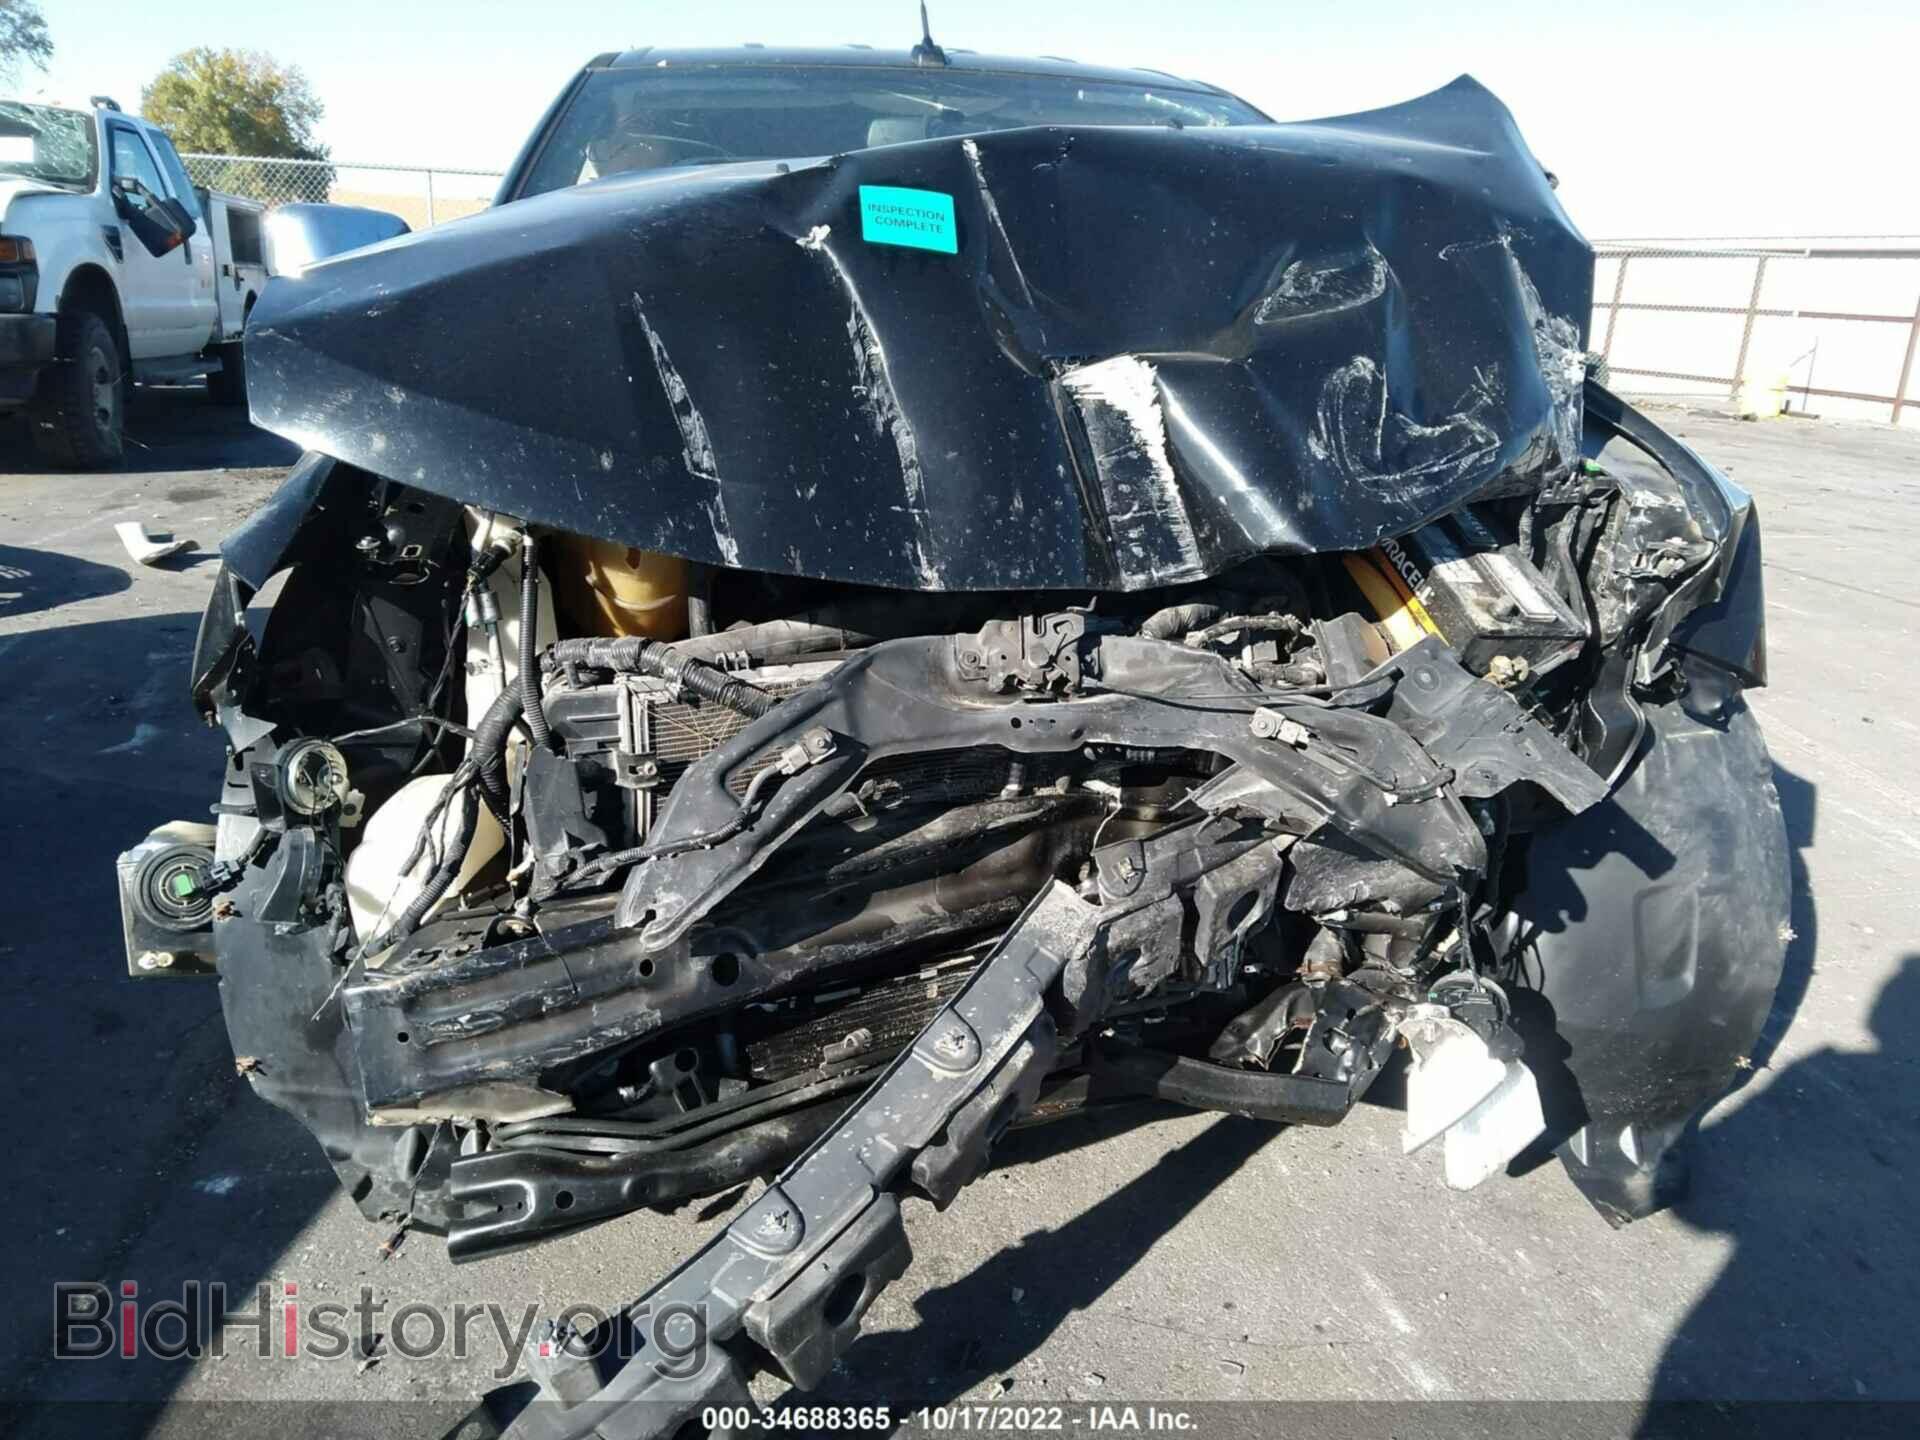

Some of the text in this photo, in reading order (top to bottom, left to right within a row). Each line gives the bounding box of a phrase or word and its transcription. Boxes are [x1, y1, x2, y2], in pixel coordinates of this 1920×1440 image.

[867, 202, 945, 222] INSPECTION
[874, 215, 944, 234] COMPLETE
[1385, 539, 1431, 606] RACELL
